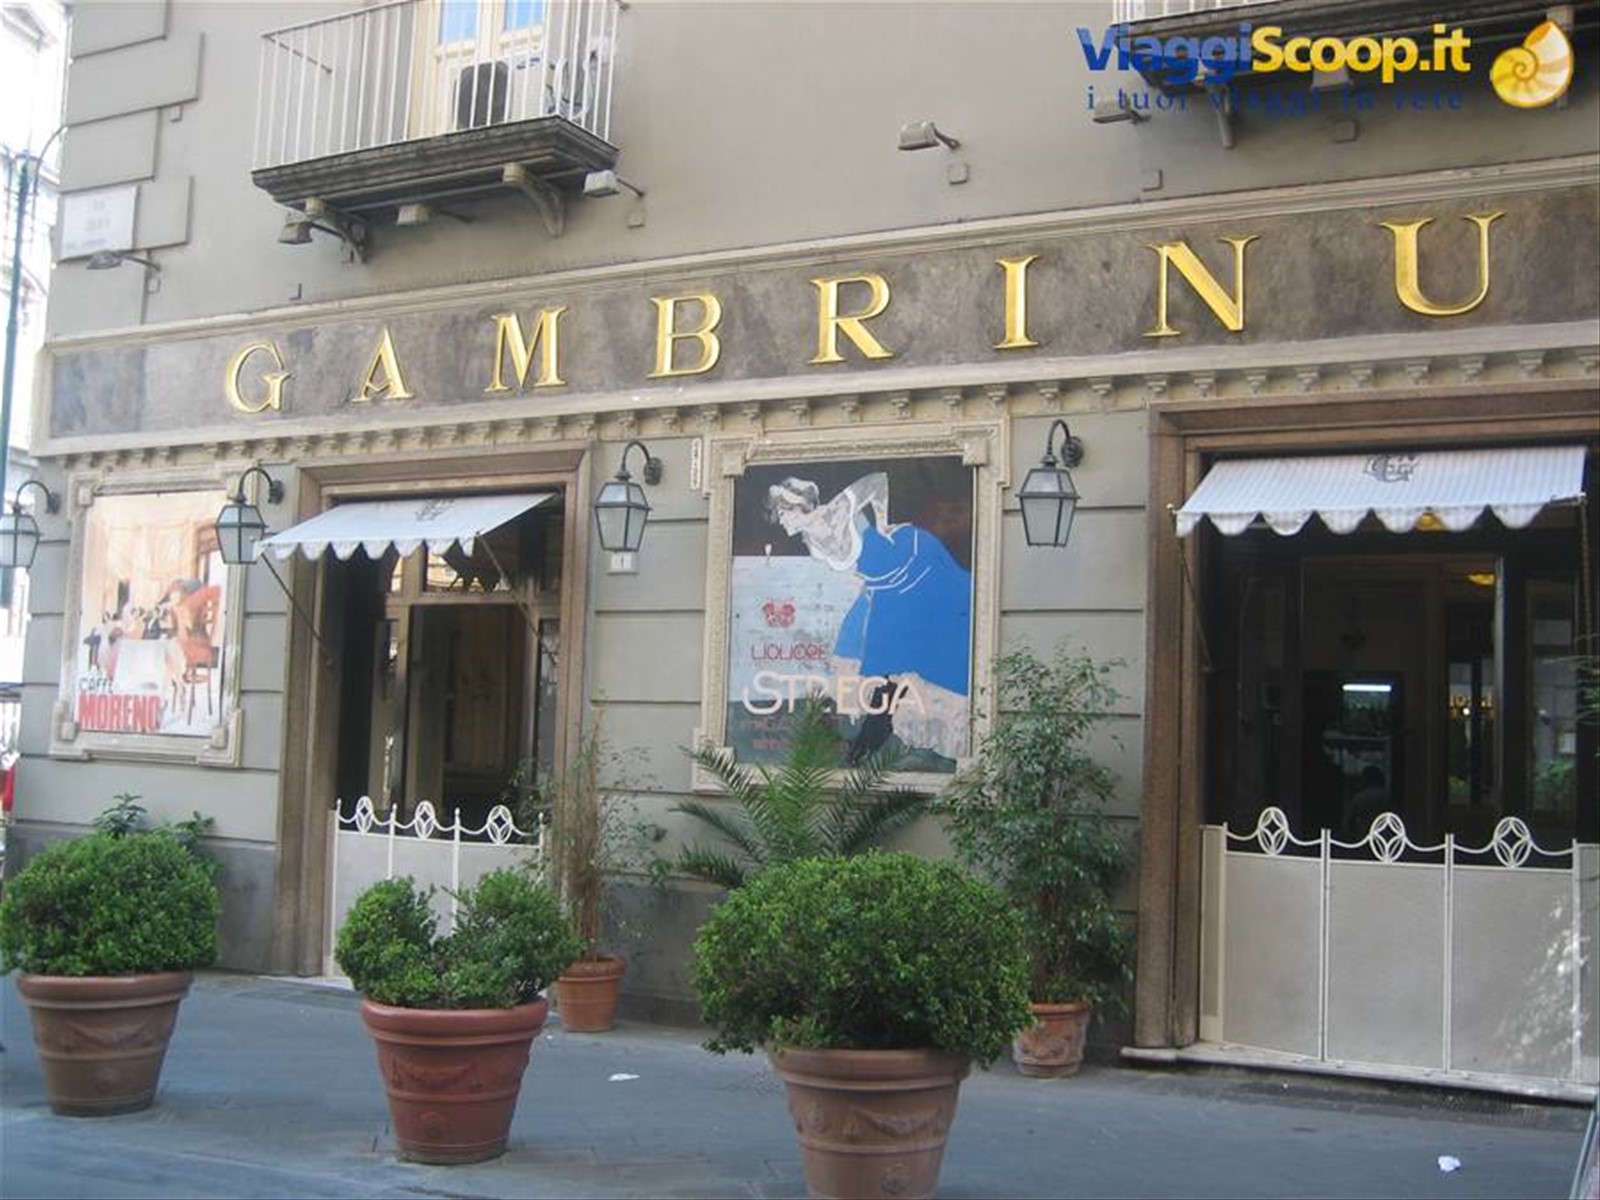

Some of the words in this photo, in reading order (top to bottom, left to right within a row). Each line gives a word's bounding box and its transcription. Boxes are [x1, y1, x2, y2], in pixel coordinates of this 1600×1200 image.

[225, 210, 1506, 415] GAMBRINU
[751, 642, 827, 660] LIQUORE
[79, 693, 161, 731] MORENO
